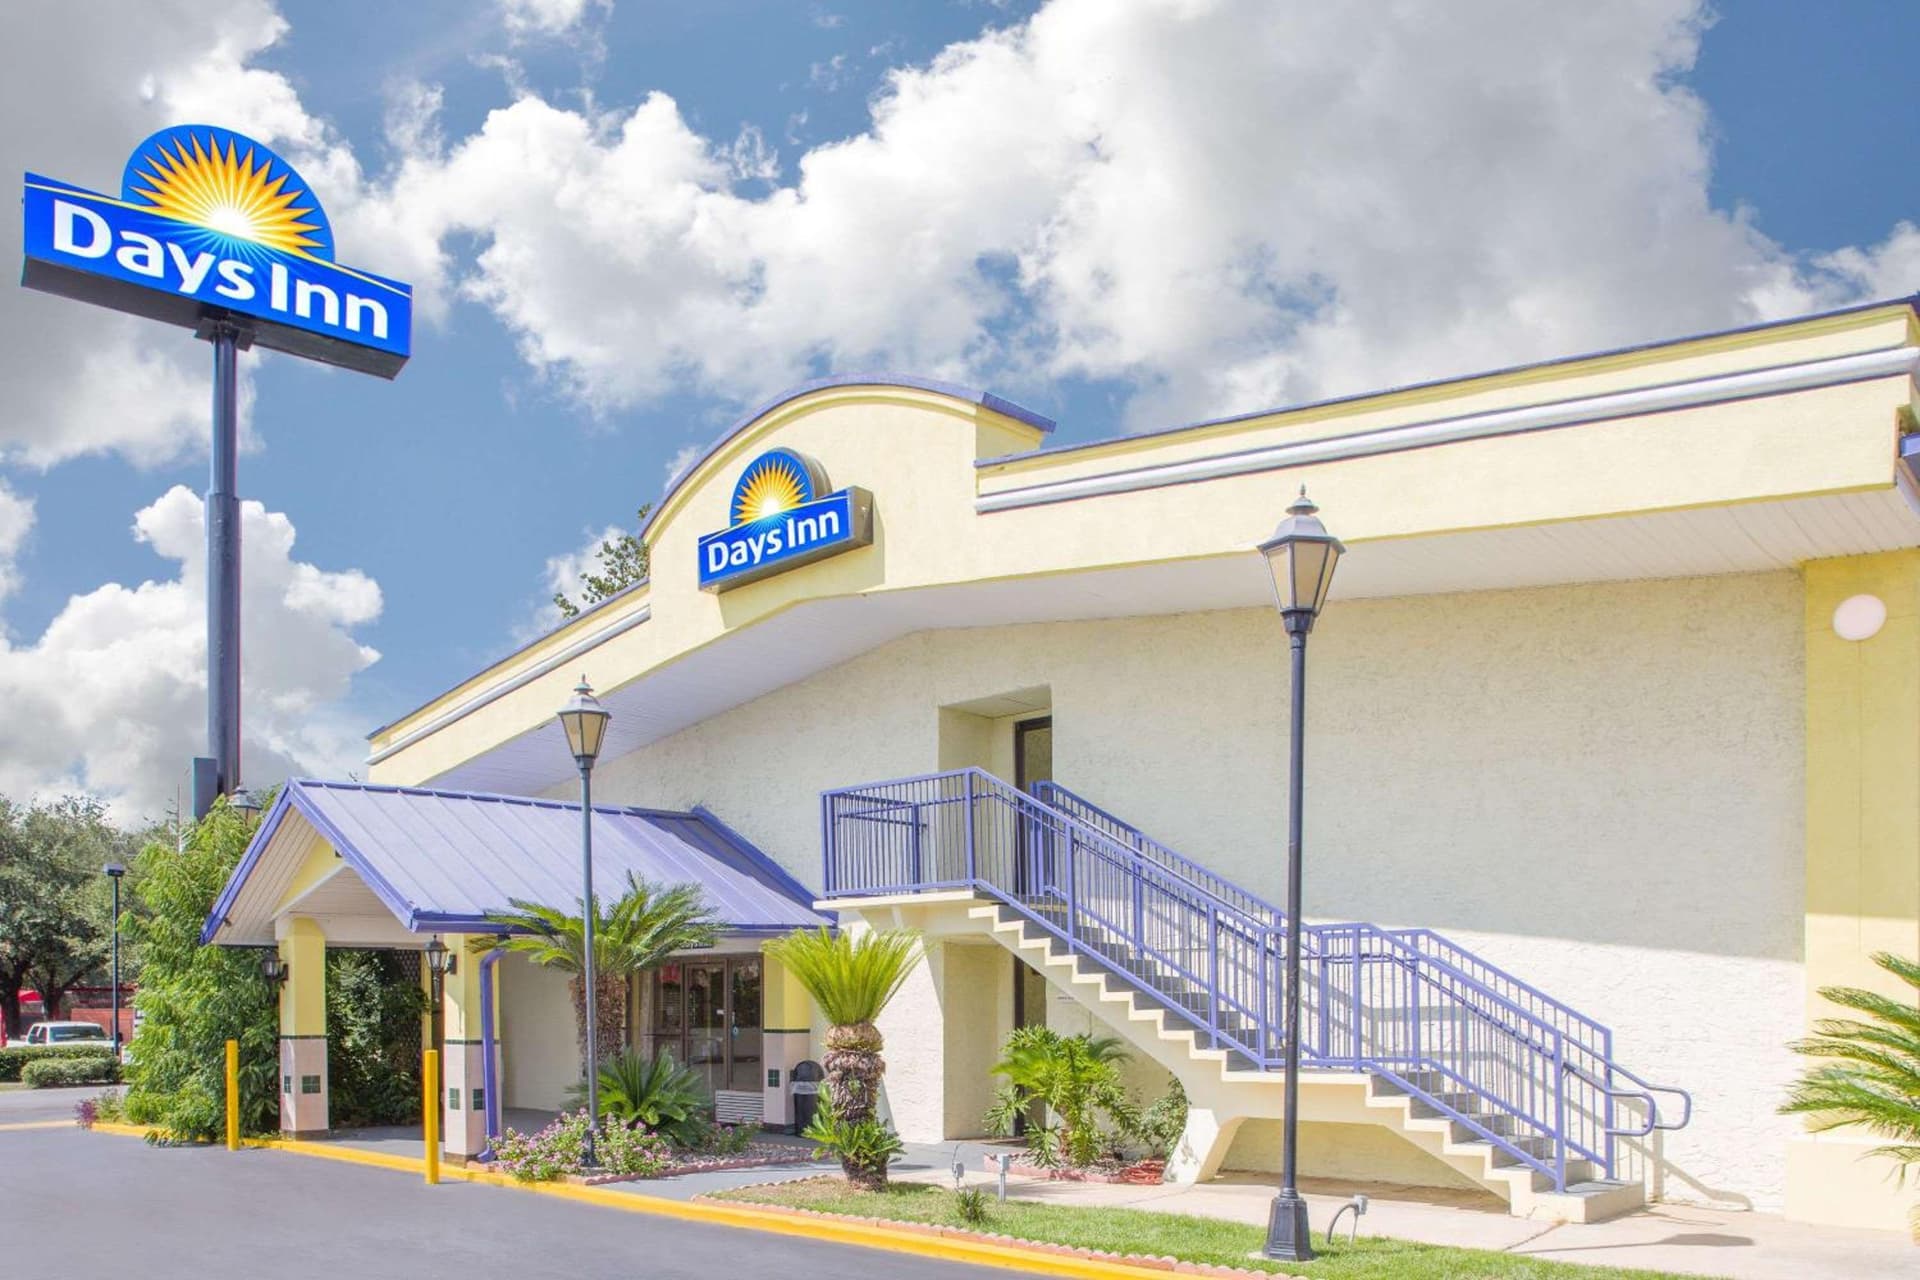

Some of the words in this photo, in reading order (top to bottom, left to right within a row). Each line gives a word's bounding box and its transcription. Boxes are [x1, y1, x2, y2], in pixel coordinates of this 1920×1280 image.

[54, 200, 256, 299] Days
[271, 263, 388, 339] Inn
[708, 529, 782, 573] Days
[787, 510, 839, 548] Inn
